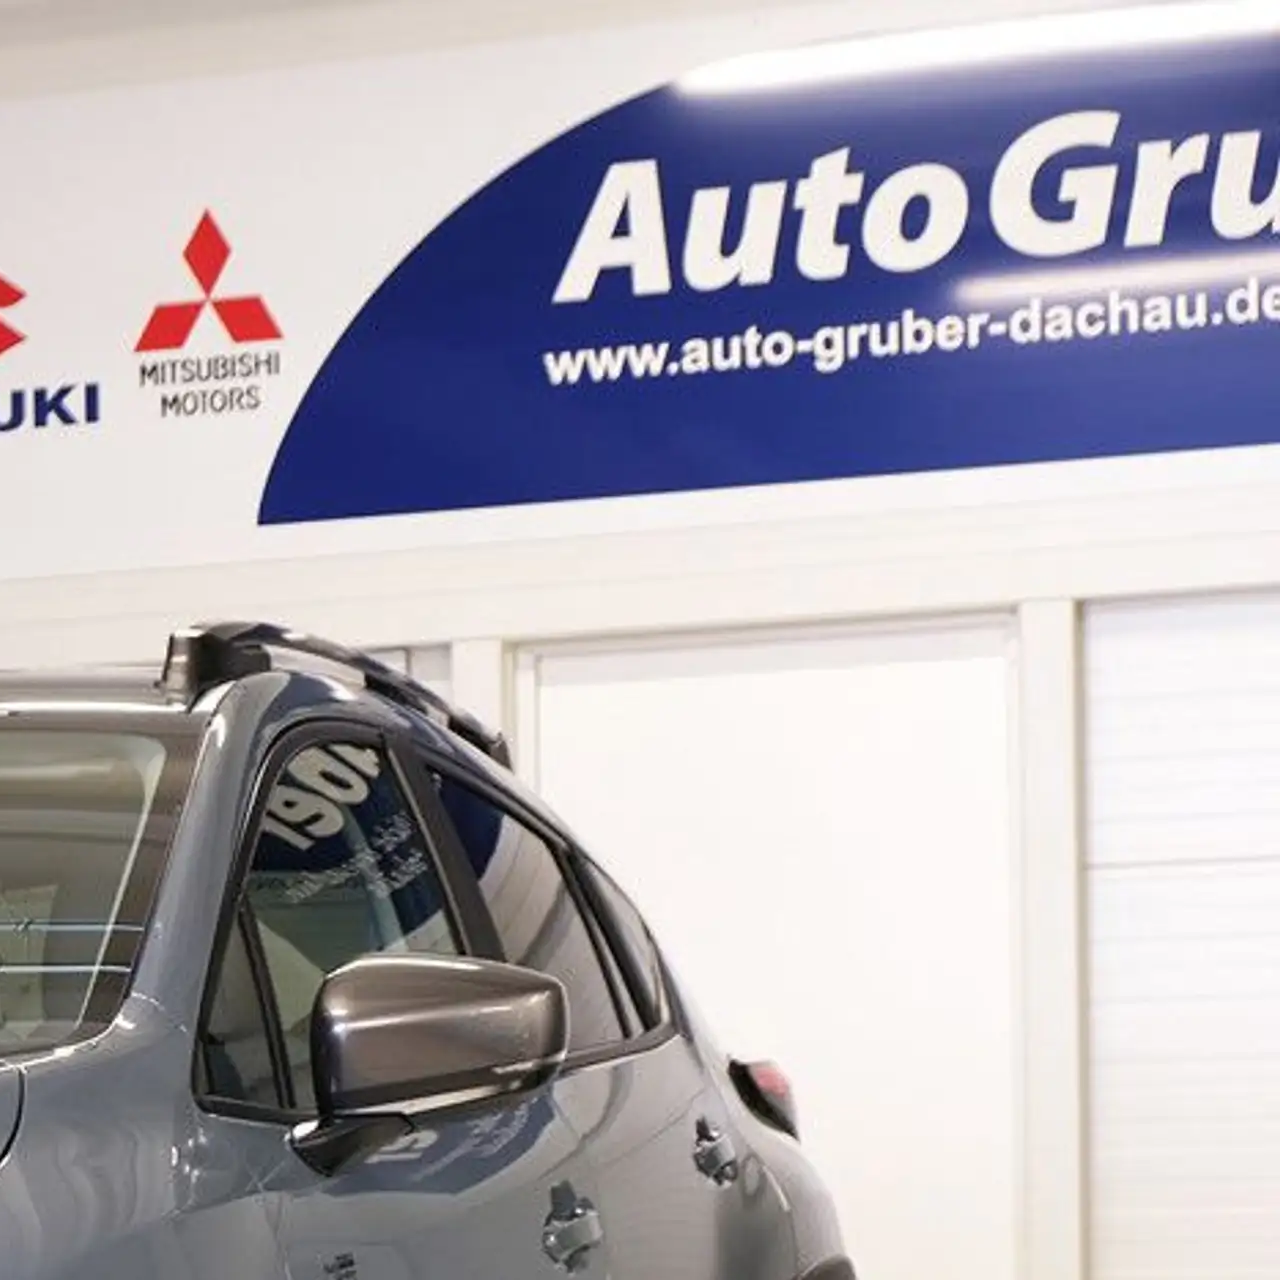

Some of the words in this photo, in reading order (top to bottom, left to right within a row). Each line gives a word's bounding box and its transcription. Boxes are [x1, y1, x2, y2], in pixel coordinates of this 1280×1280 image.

[543, 277, 1280, 387] www.auto-gruber-dachau.de
[138, 351, 281, 387] MITSUBISHI
[160, 386, 262, 418] MOTORS
